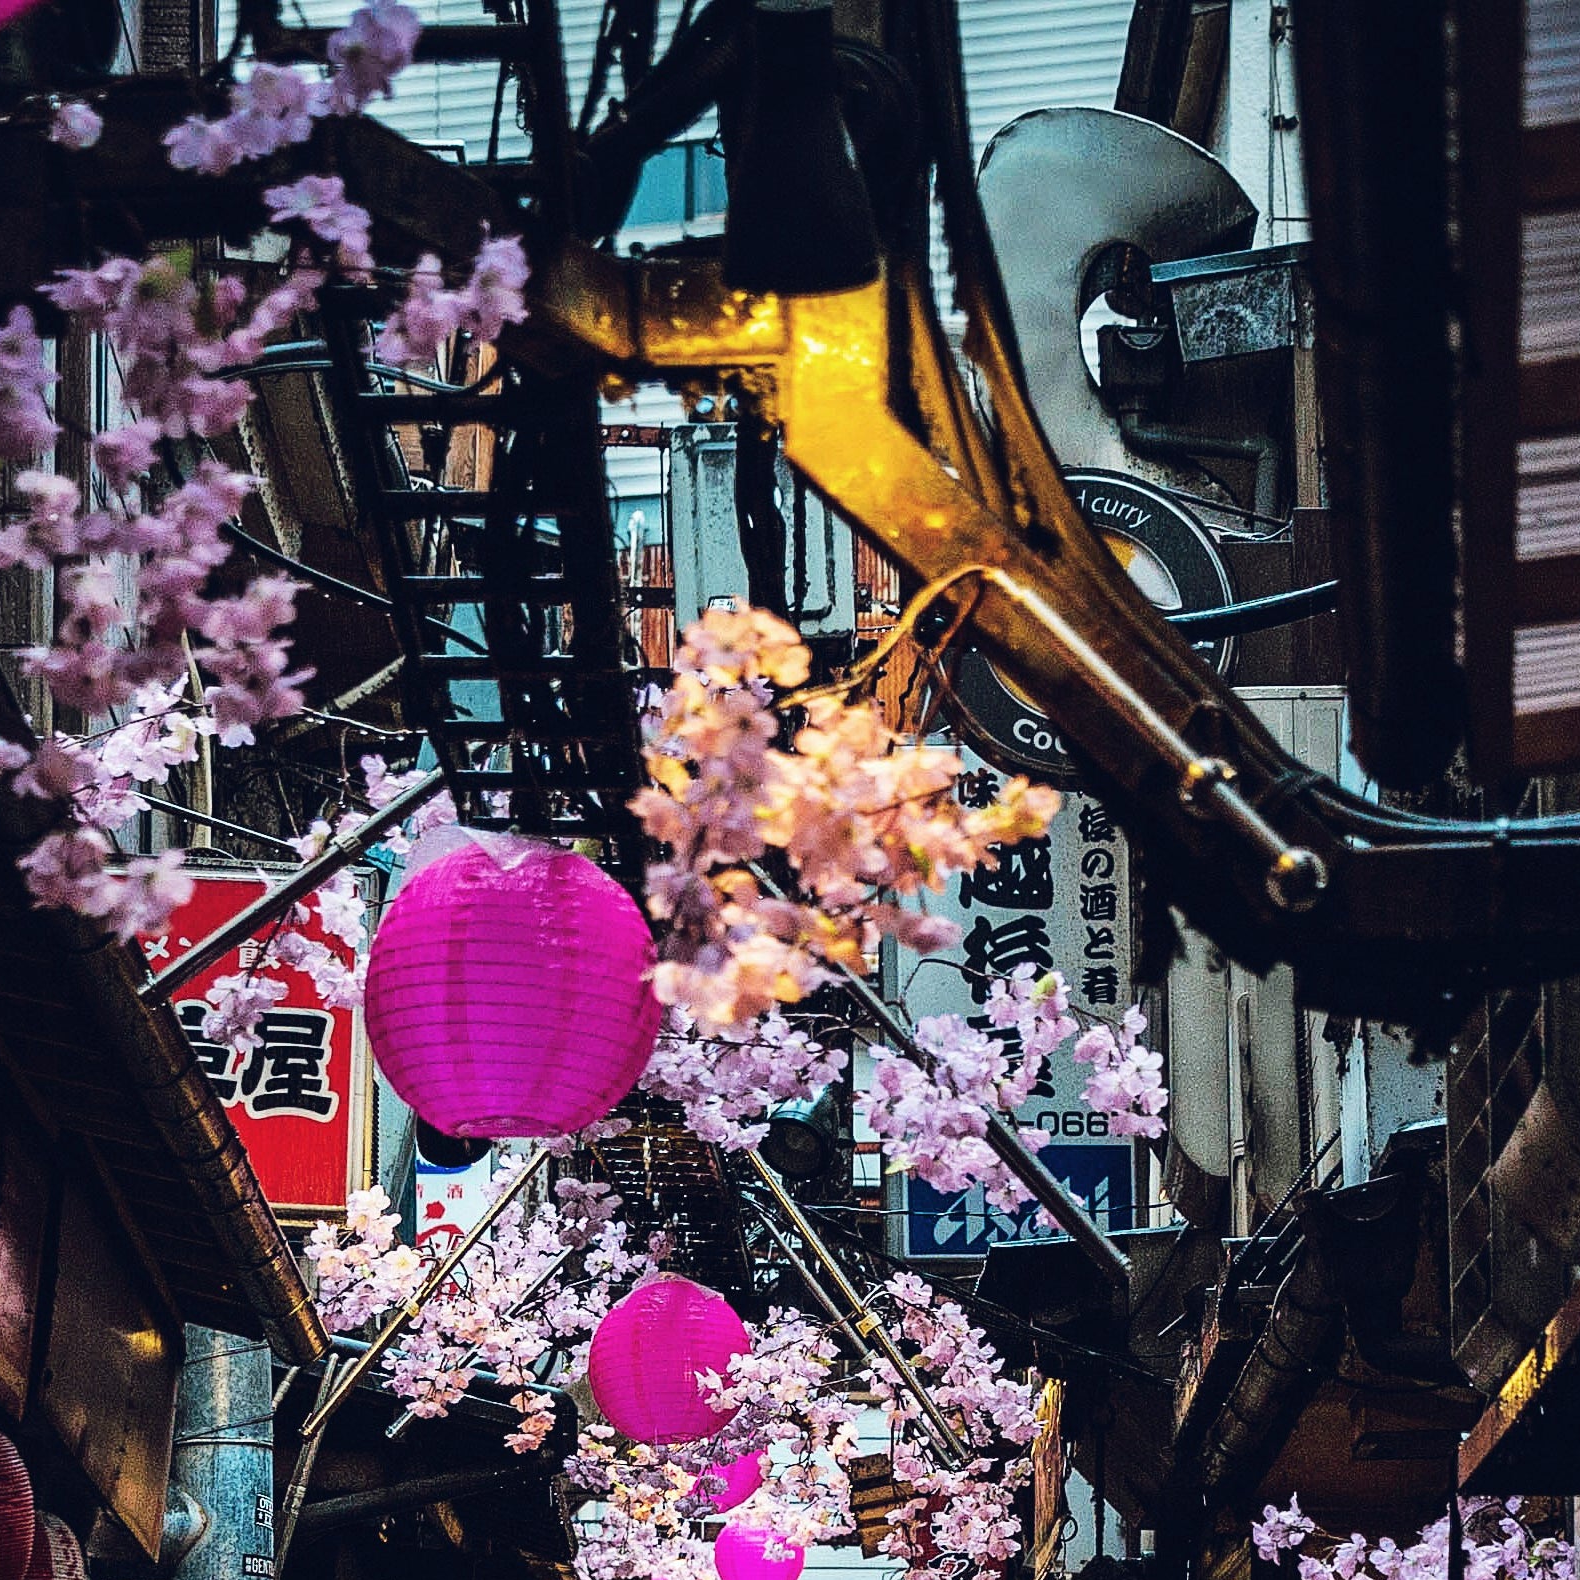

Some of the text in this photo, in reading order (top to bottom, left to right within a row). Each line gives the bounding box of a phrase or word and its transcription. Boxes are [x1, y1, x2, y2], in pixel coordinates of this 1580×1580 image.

[1090, 496, 1152, 529] curry
[1077, 789, 1118, 1005] 後の酒と肴
